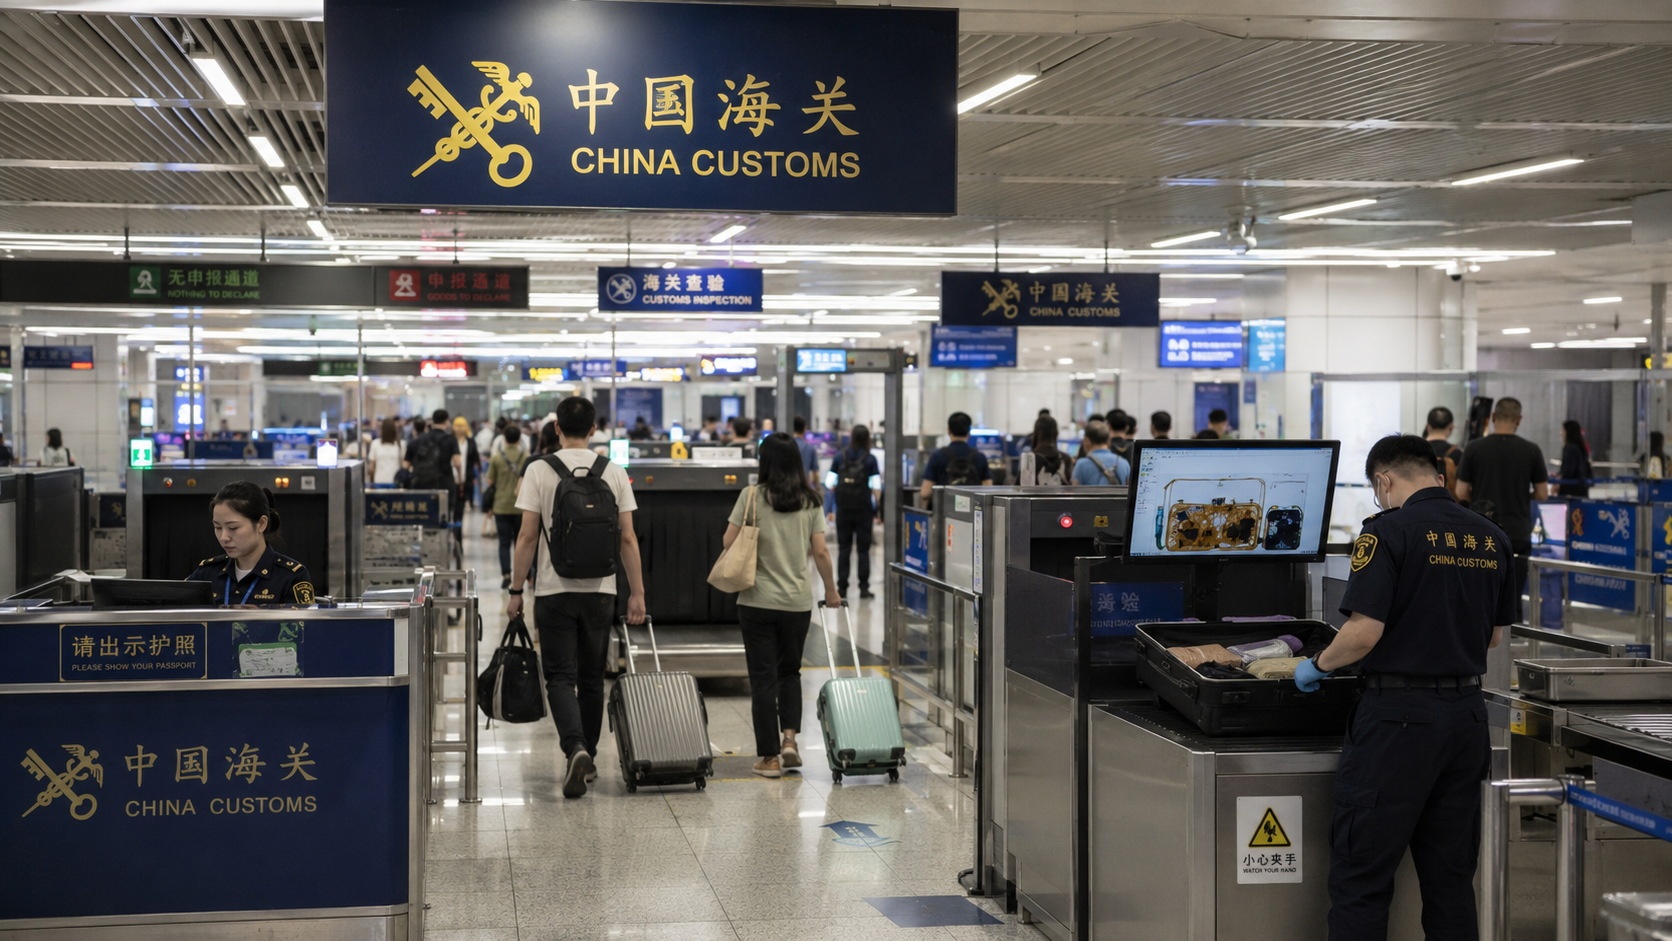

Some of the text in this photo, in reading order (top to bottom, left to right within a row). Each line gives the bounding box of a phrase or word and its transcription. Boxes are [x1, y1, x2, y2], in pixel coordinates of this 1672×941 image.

[568, 69, 860, 137] 中国海关
[571, 146, 861, 179] CHINA CUSTOMS
[168, 268, 260, 287] 无申报通道
[428, 272, 512, 289] 申报通道
[642, 273, 725, 292] 海关查验
[168, 290, 206, 298] NOTHING
[208, 290, 221, 298] TO
[459, 293, 471, 301] TO
[642, 294, 753, 306] CUSTOMS INSPECTION
[1029, 280, 1120, 304] 中国海关
[1029, 306, 1121, 317] CHINA CUSTOMS
[1426, 529, 1497, 553] 中国海关
[1429, 554, 1498, 570] CHINA CUSTOMS
[71, 634, 196, 658] 请出示护照
[71, 661, 197, 671] PLEASE SHOW YOUR PASSPORT
[124, 742, 318, 788] 中国海关
[125, 795, 318, 817] CHINA CUSTOMS
[1243, 853, 1297, 866] 小心夹手
